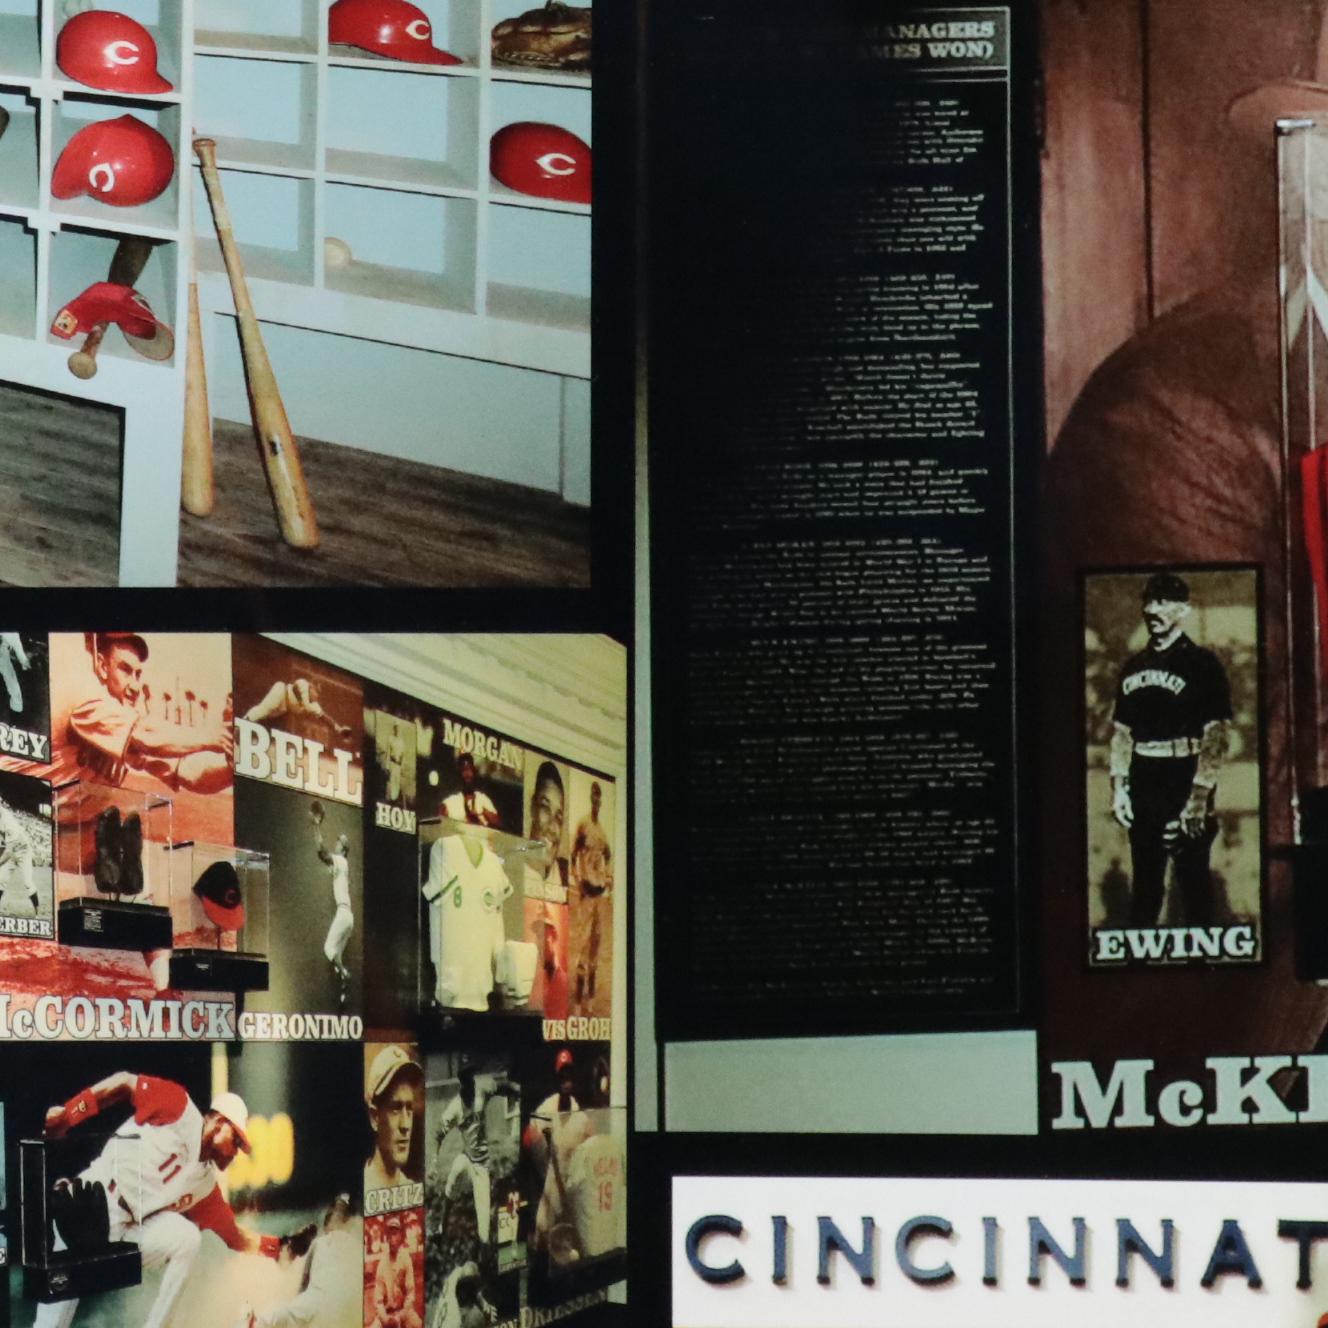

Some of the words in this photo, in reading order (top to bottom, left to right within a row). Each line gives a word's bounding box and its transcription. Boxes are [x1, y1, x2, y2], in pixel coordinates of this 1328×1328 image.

[927, 40, 995, 59] WON)
[442, 718, 523, 770] MORGAN
[235, 717, 364, 807] BELL
[376, 801, 417, 835] HOY
[1096, 926, 1255, 961] EWING
[237, 1011, 364, 1040] GERONIMO
[566, 1015, 612, 1041] GROH
[366, 1182, 424, 1214] CRITZ
[685, 1214, 1328, 1291] CINCINNAT
